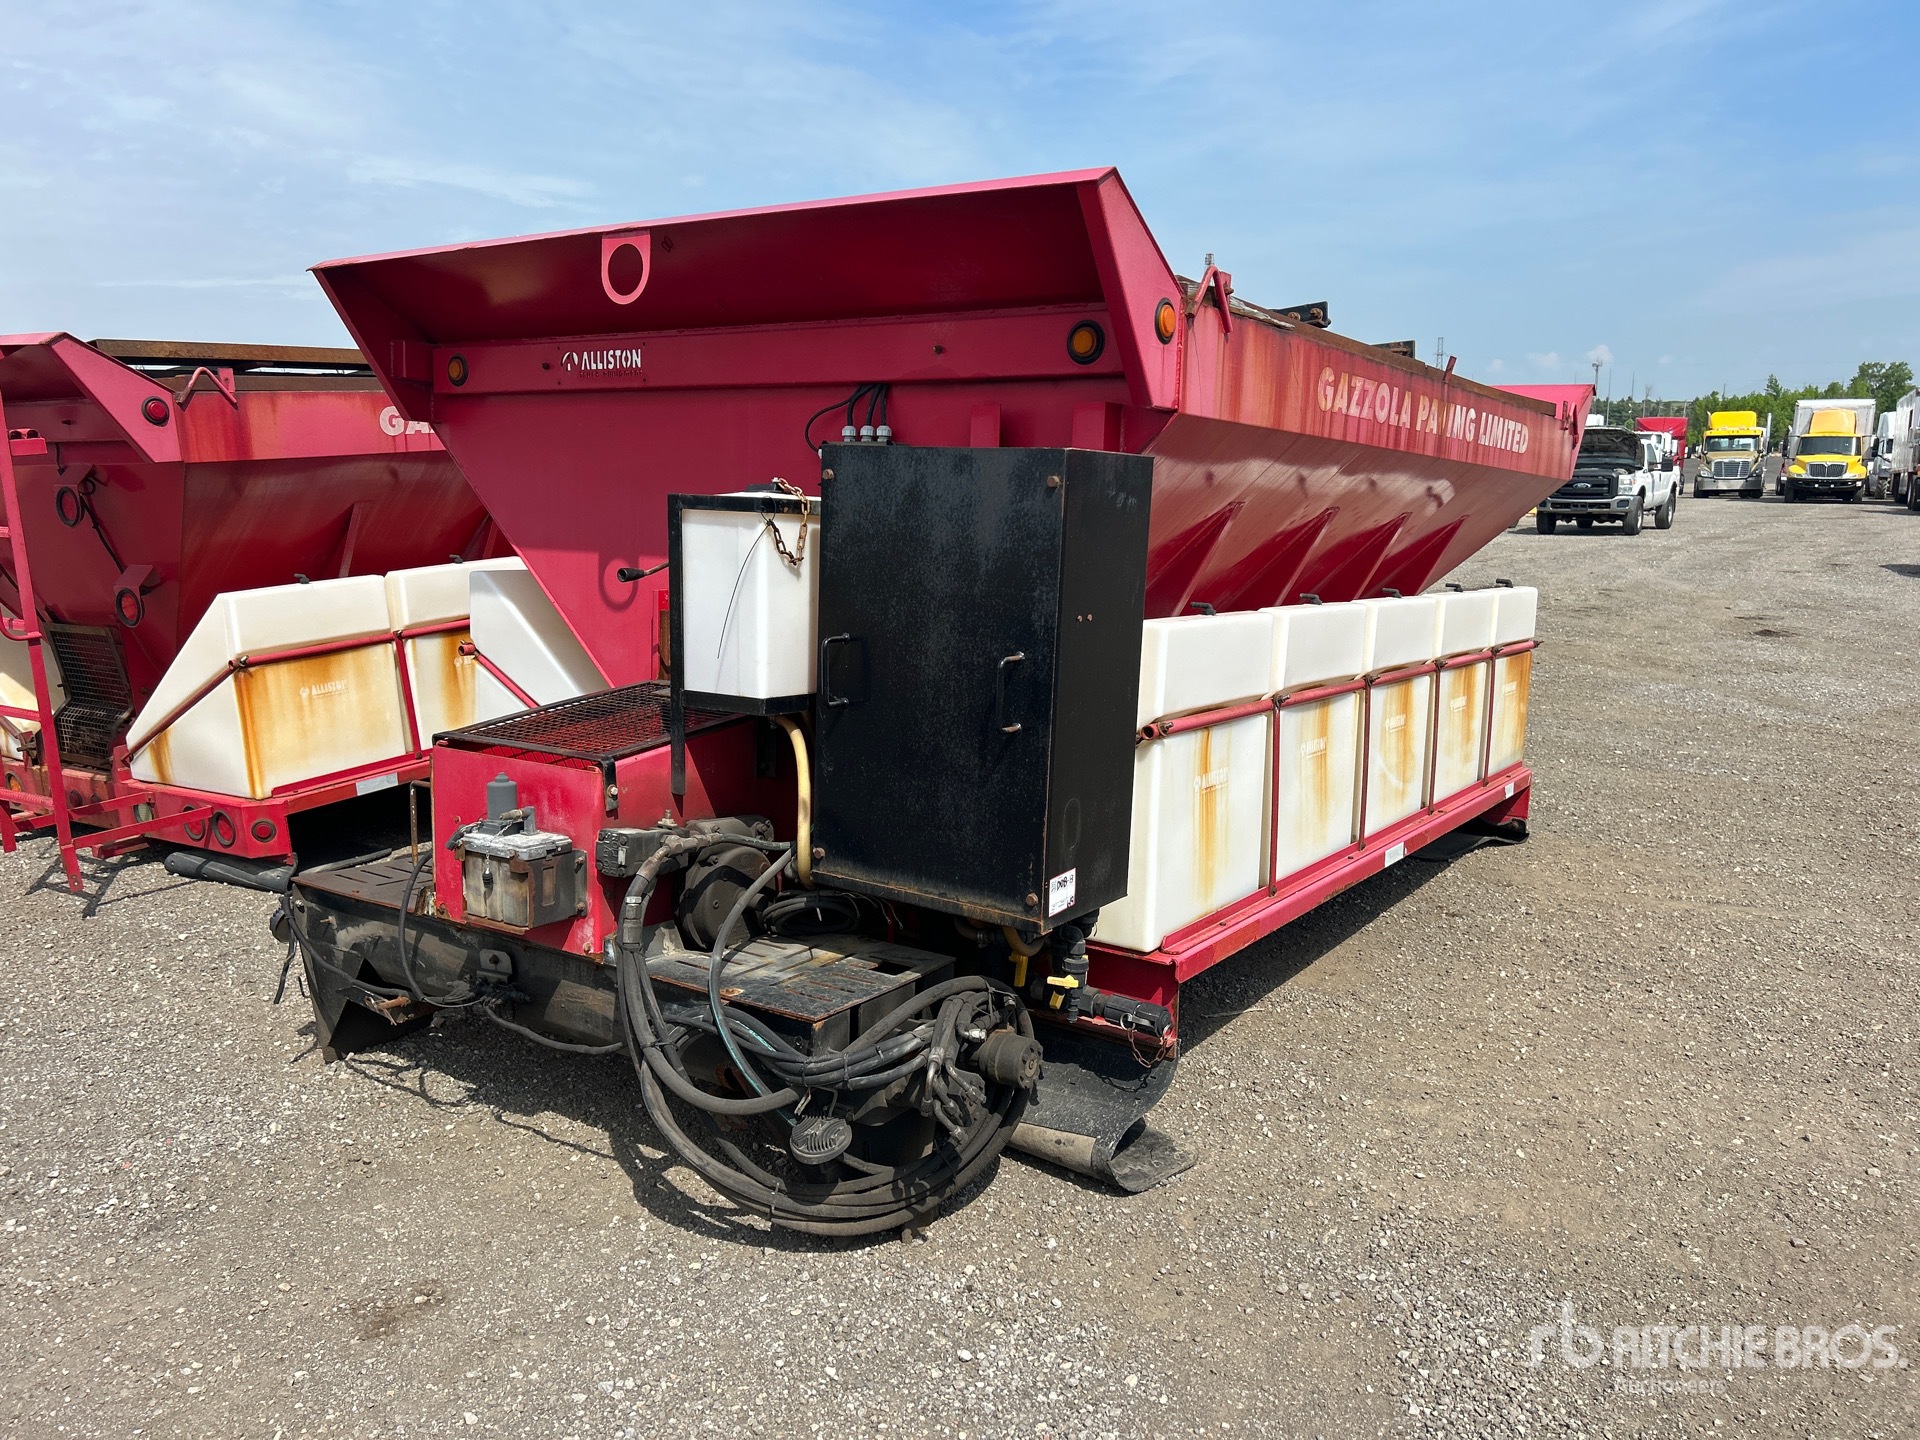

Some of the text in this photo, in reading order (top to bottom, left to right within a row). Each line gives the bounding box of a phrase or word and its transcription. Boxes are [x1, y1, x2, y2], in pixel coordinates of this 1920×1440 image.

[581, 348, 642, 371] ALLISTON
[1317, 366, 1412, 429] GAZZOLA
[1478, 411, 1529, 454] LIMITED
